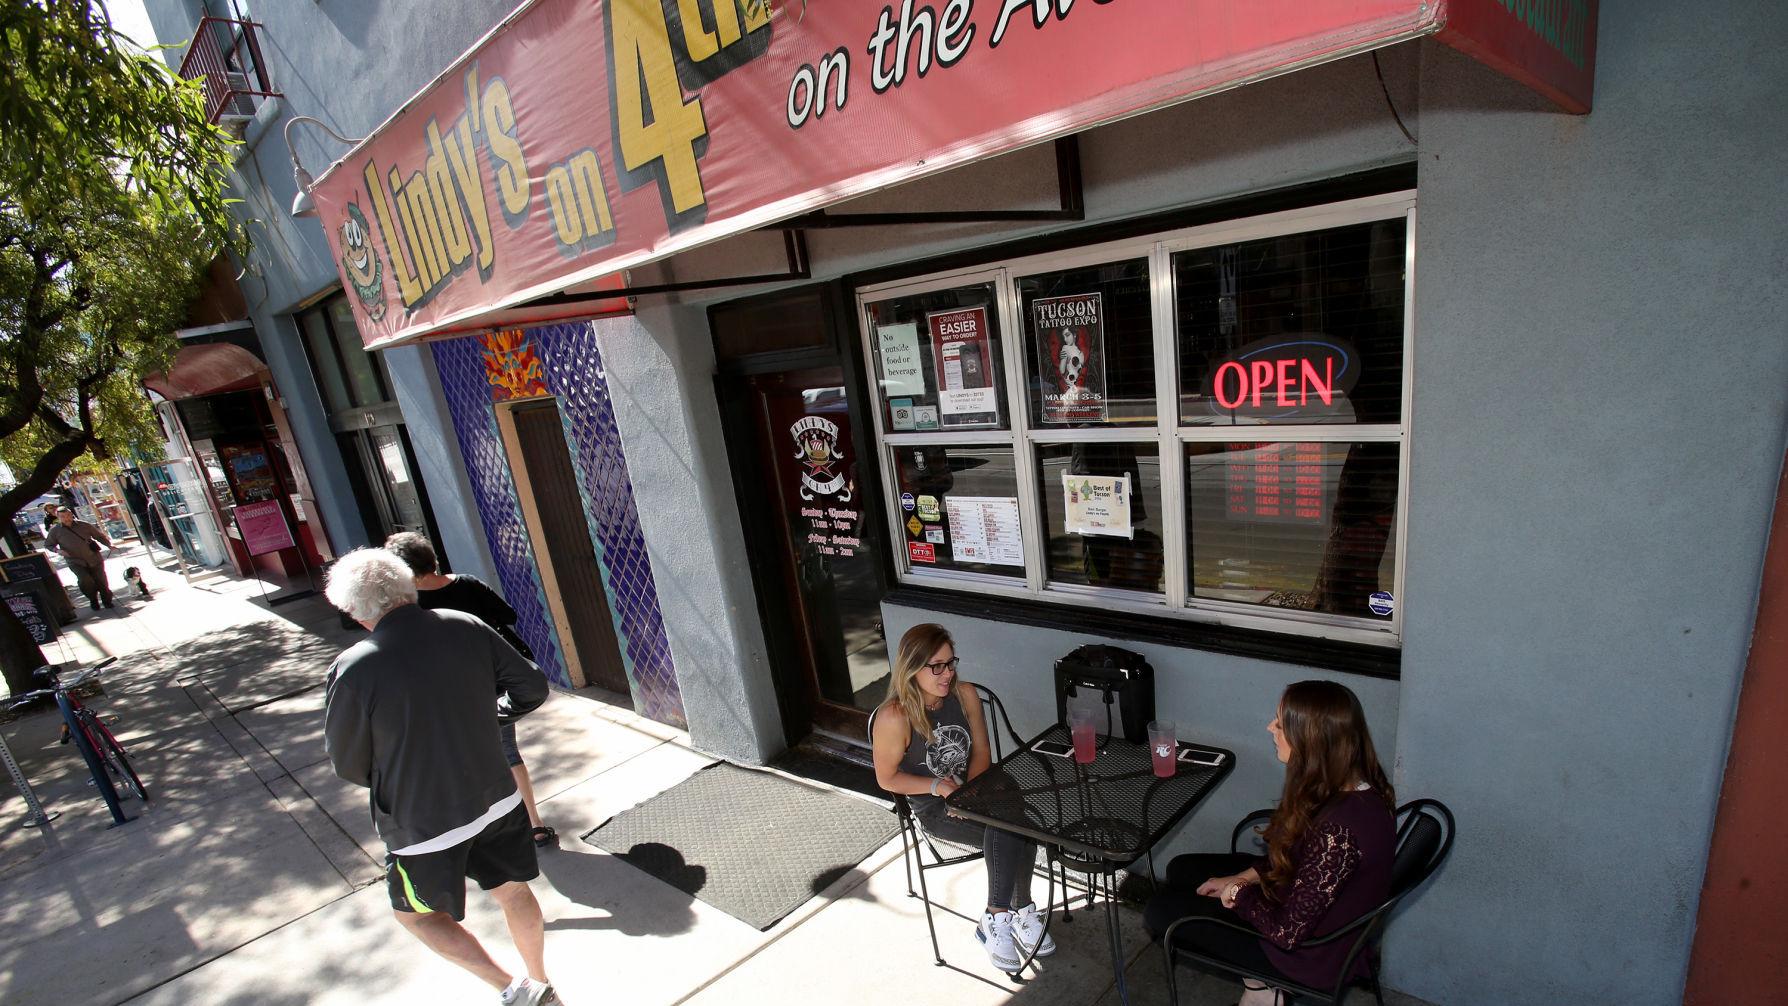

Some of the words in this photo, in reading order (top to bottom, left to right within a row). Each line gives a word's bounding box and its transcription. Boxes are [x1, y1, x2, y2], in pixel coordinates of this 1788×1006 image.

[787, 46, 850, 129] on
[867, 0, 977, 94] the
[545, 148, 614, 252] on
[1038, 299, 1096, 319] TUCSON
[938, 313, 966, 324] CRAVING
[966, 312, 976, 320] AN
[1039, 317, 1072, 328] TATTOO
[1074, 315, 1098, 326] EXPO
[940, 320, 977, 335] EASIER
[883, 334, 894, 342] No
[885, 344, 909, 353] outside
[886, 355, 902, 364] food
[888, 367, 917, 376] beverage
[1213, 356, 1334, 409] OPEN
[1045, 393, 1079, 401] MARCH
[1081, 392, 1102, 400] 3-5
